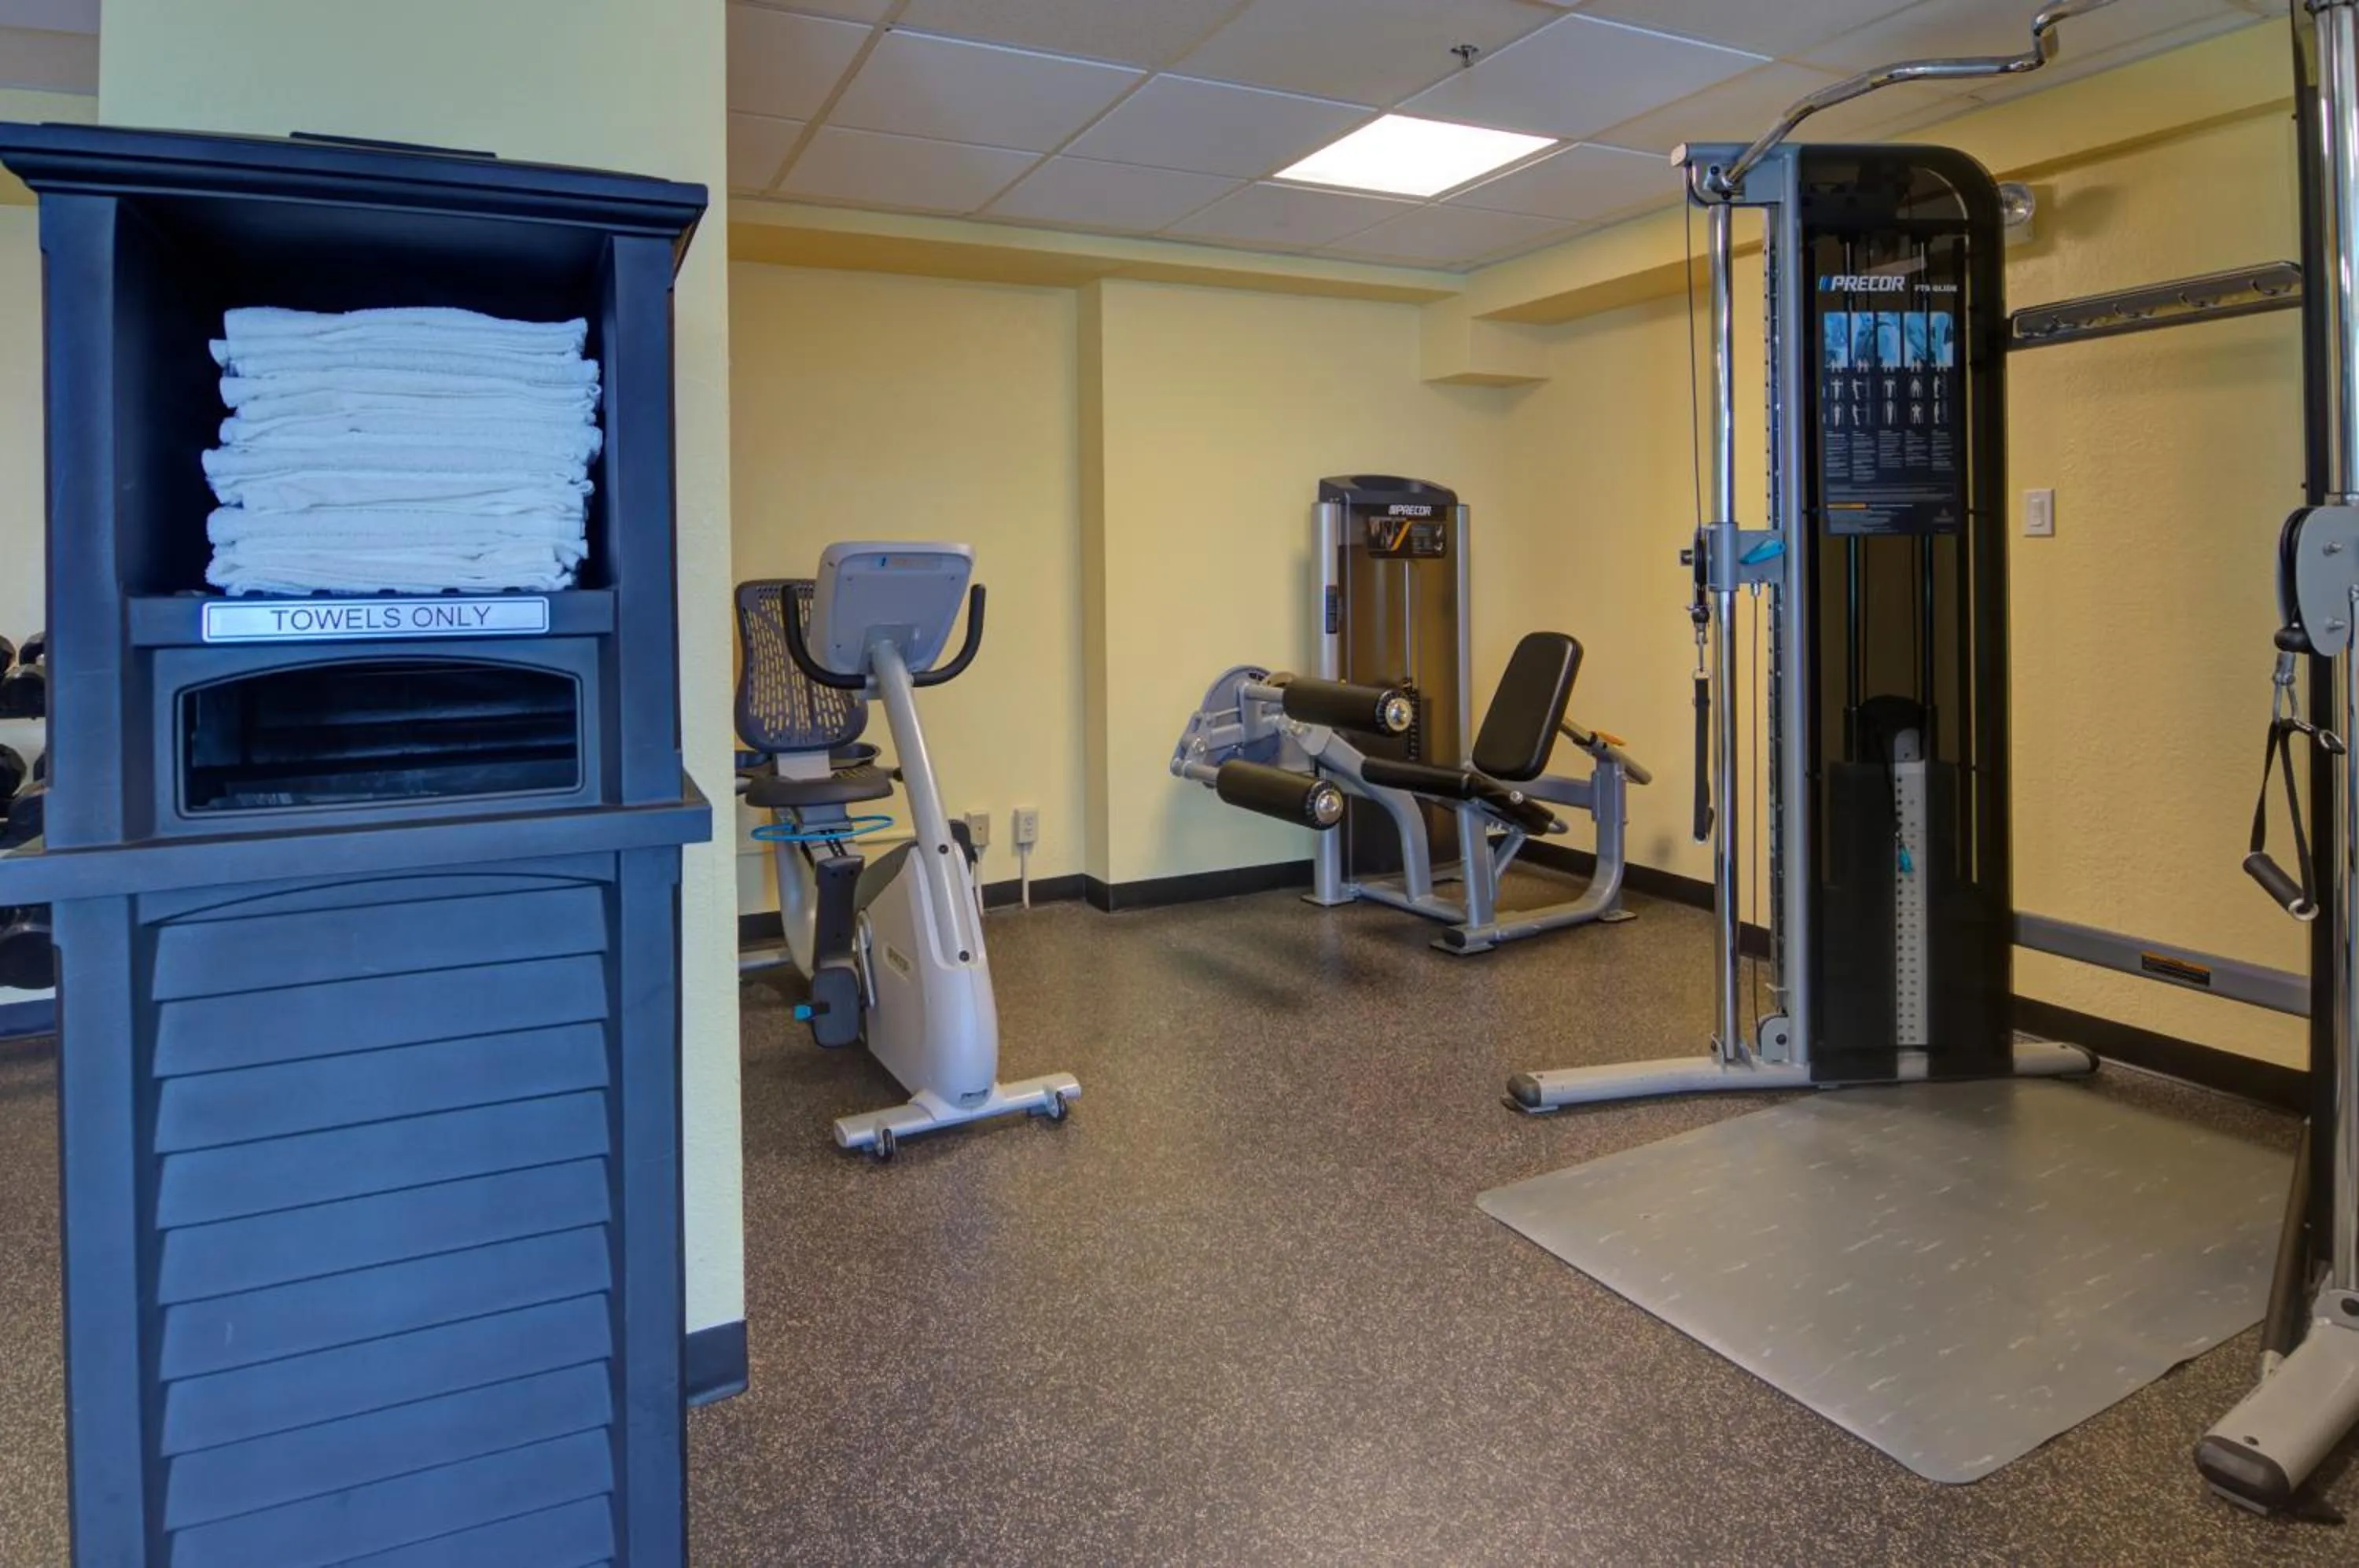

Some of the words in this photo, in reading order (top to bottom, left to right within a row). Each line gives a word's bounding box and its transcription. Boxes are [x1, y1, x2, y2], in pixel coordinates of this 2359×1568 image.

[1831, 276, 1905, 292] PRECOR
[270, 607, 401, 631] TOWELS
[413, 605, 491, 628] ONLY
